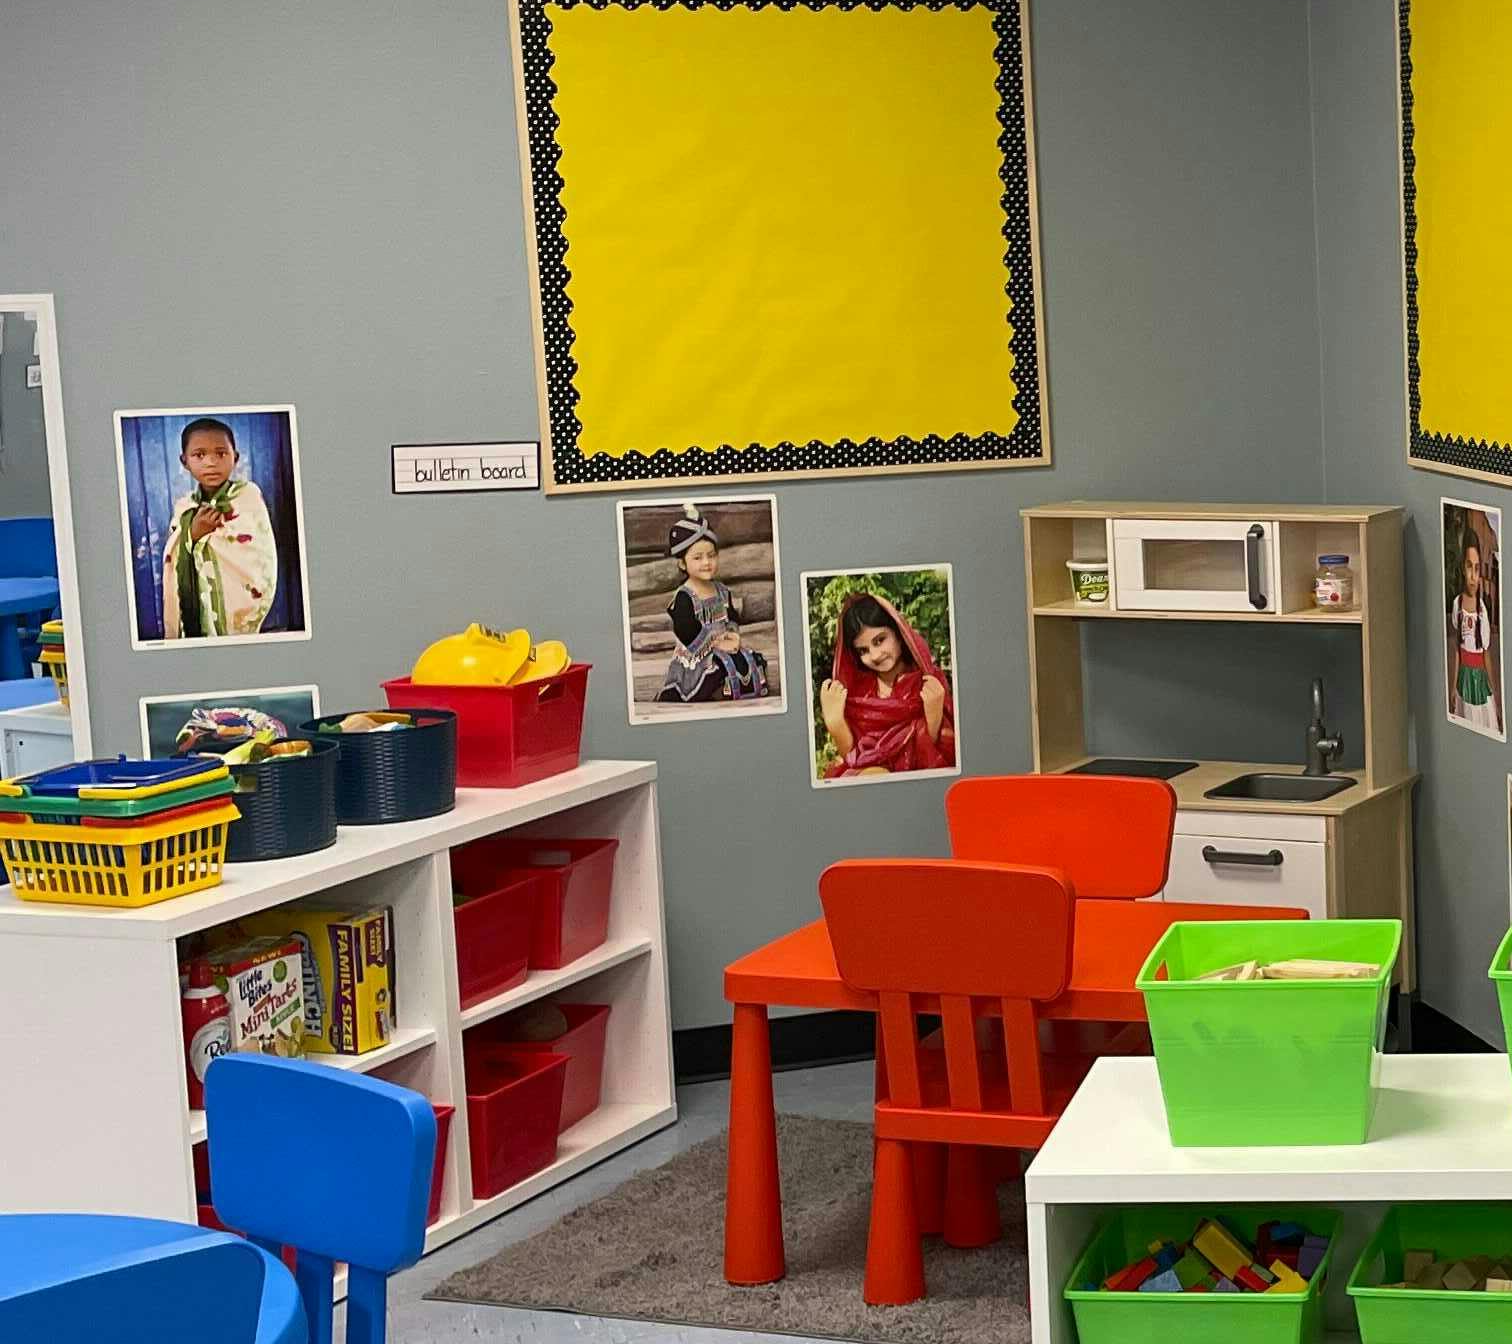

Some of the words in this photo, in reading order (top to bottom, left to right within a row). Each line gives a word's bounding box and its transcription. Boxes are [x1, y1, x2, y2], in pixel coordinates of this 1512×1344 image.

[414, 458, 470, 483] bulletin
[479, 455, 527, 480] board
[337, 929, 353, 1002] FAMILY
[238, 969, 263, 1001] Little
[248, 979, 272, 1008] Bites
[240, 1006, 270, 1040] Mini
[268, 977, 297, 1014] Tarts
